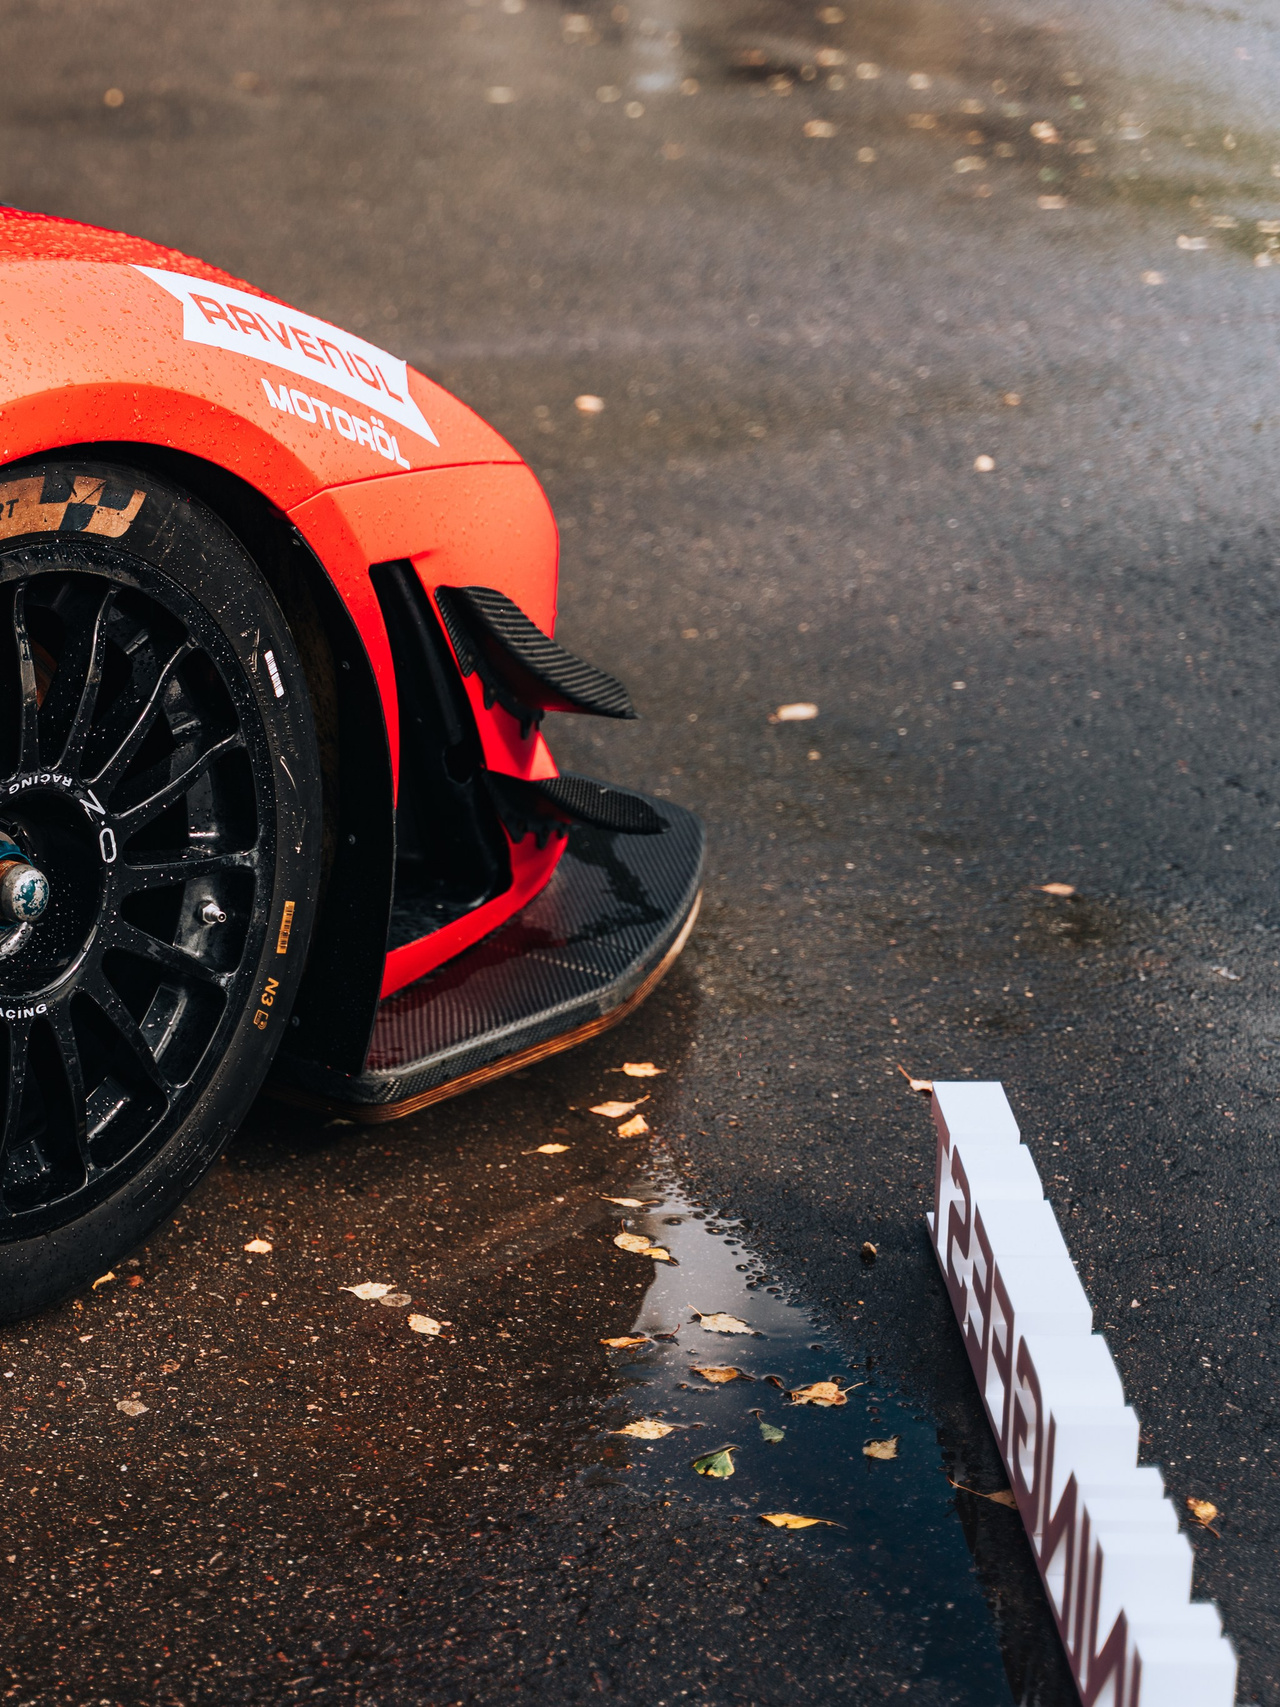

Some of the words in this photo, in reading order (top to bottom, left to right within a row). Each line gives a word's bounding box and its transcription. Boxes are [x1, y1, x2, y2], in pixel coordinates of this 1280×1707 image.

[188, 292, 405, 403] RAVENOL
[261, 378, 410, 470] MOTORÖL
[8, 773, 73, 795] RACING
[261, 976, 280, 1008] N3
